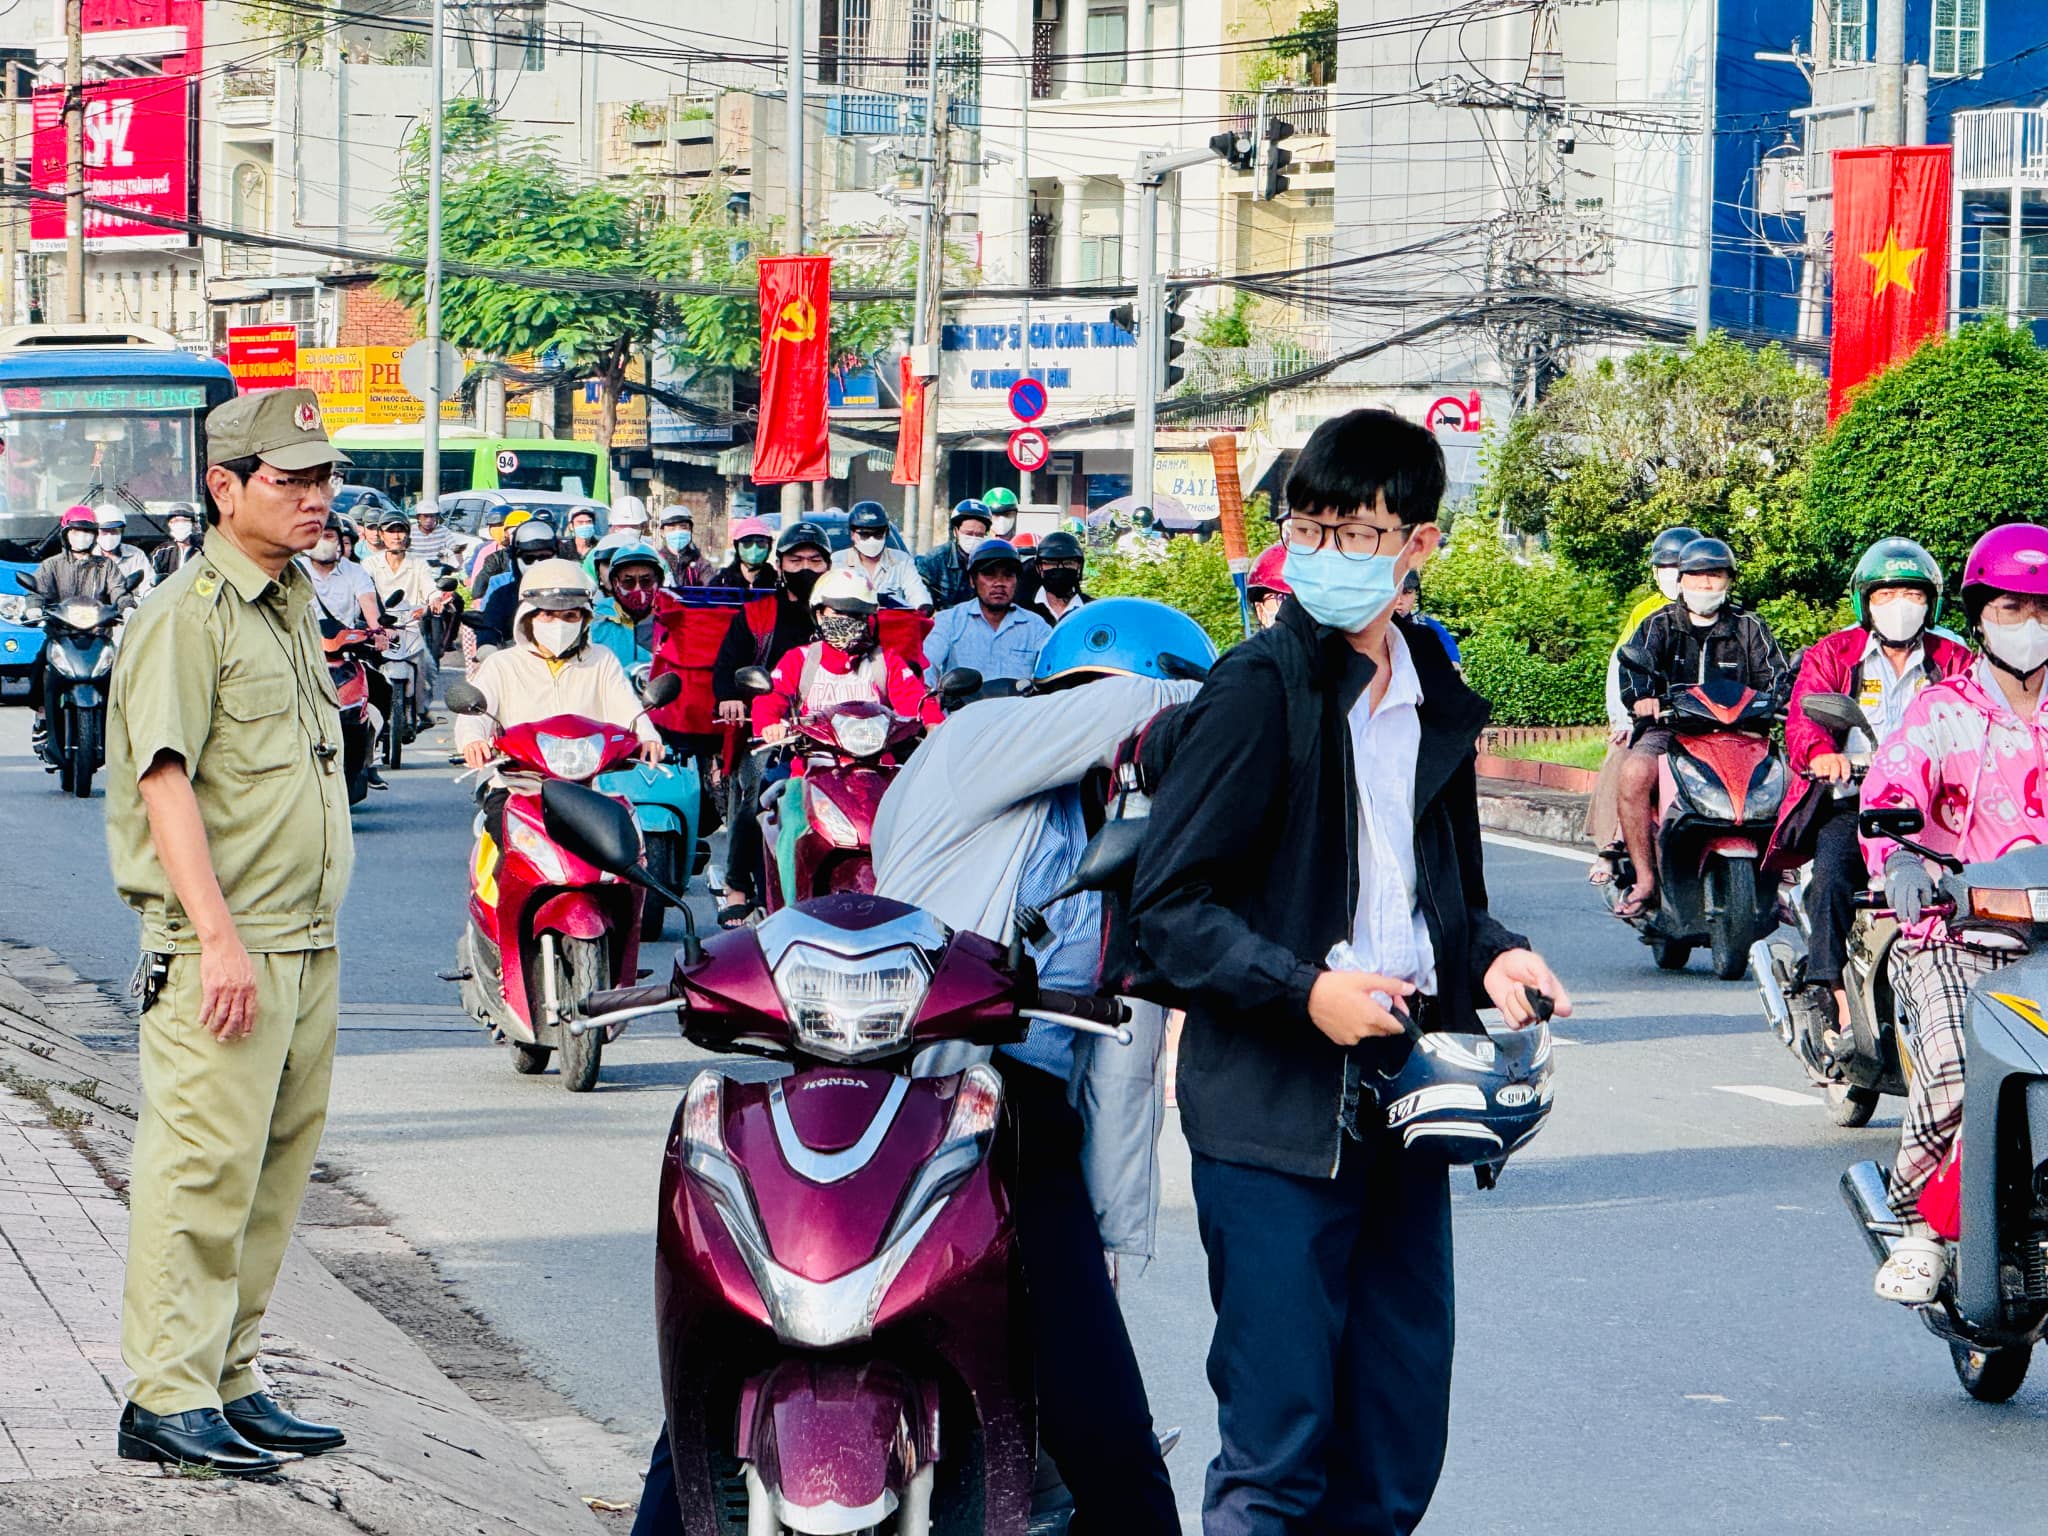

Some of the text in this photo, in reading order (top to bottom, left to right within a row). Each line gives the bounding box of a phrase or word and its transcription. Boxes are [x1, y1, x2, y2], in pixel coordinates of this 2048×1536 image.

[84, 98, 134, 168] SHZ
[499, 455, 514, 469] 94
[1885, 559, 1918, 571] Grab
[802, 1077, 869, 1090] HONDA
